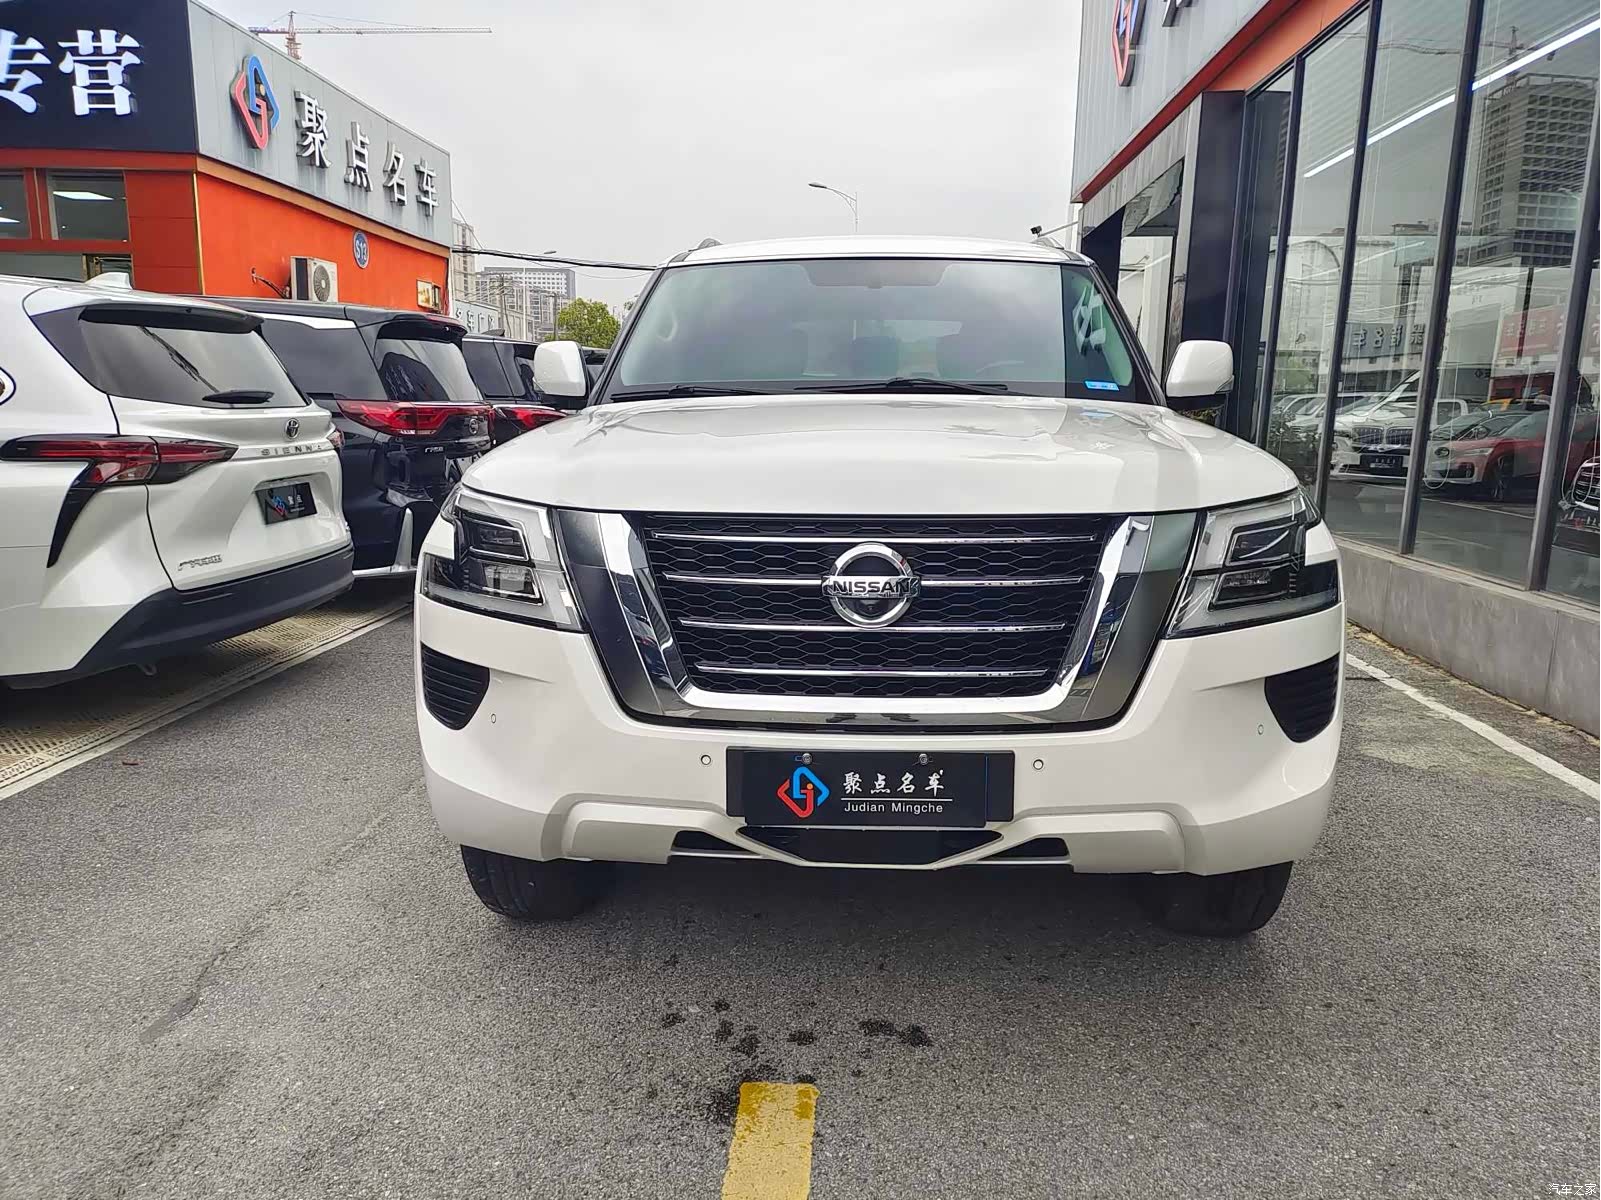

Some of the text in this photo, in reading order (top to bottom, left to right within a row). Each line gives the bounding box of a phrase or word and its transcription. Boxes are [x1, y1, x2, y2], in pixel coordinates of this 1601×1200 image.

[294, 89, 439, 217] 聚点名车
[832, 580, 910, 596] NISSAN
[843, 769, 945, 798] 聚点名车
[844, 801, 943, 814] Judian Mingche
